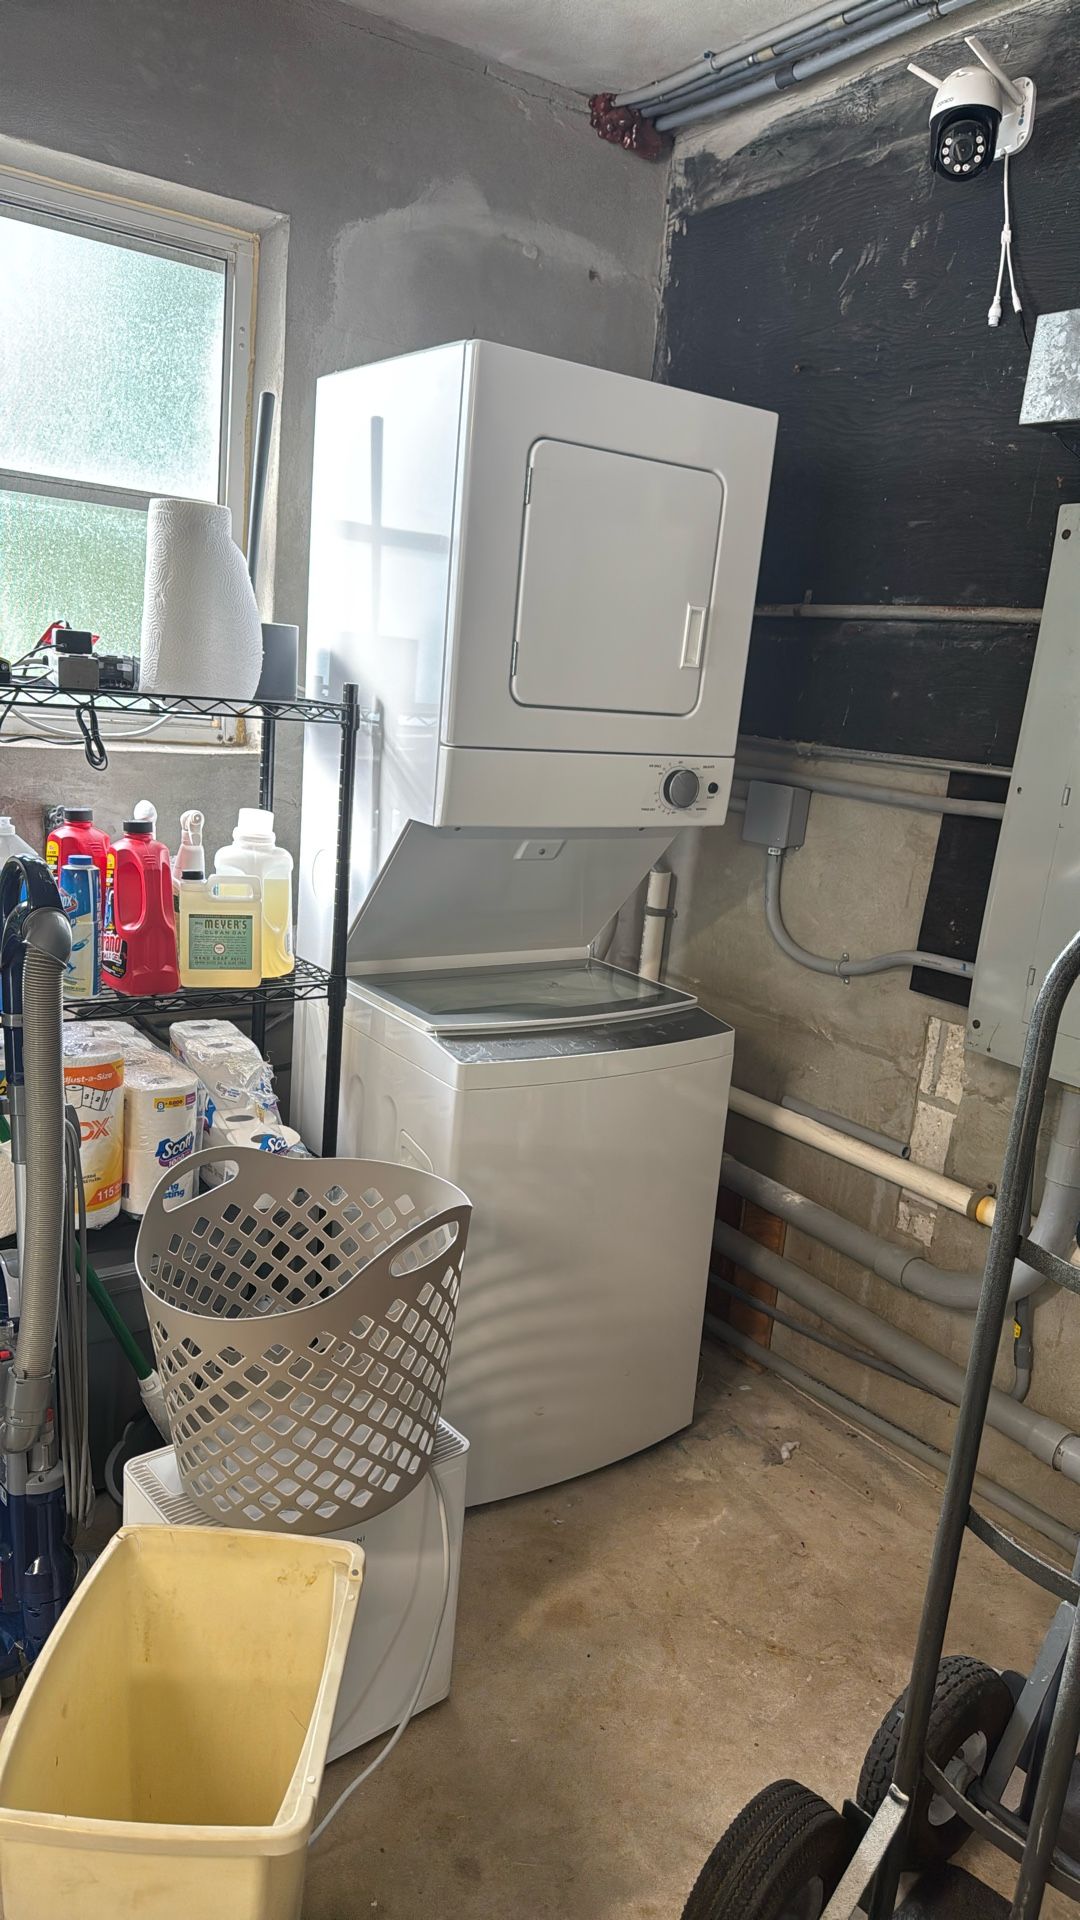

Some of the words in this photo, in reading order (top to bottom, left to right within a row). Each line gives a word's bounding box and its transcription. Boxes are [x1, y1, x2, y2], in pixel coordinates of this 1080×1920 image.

[204, 919, 248, 930] MEYER'S
[103, 934, 121, 953] rano
[64, 1072, 113, 1085] djust-a-Size
[162, 1134, 193, 1160] Scott
[265, 1136, 288, 1154] Sco
[97, 1186, 114, 1201] 115
[163, 1189, 185, 1200] sting
